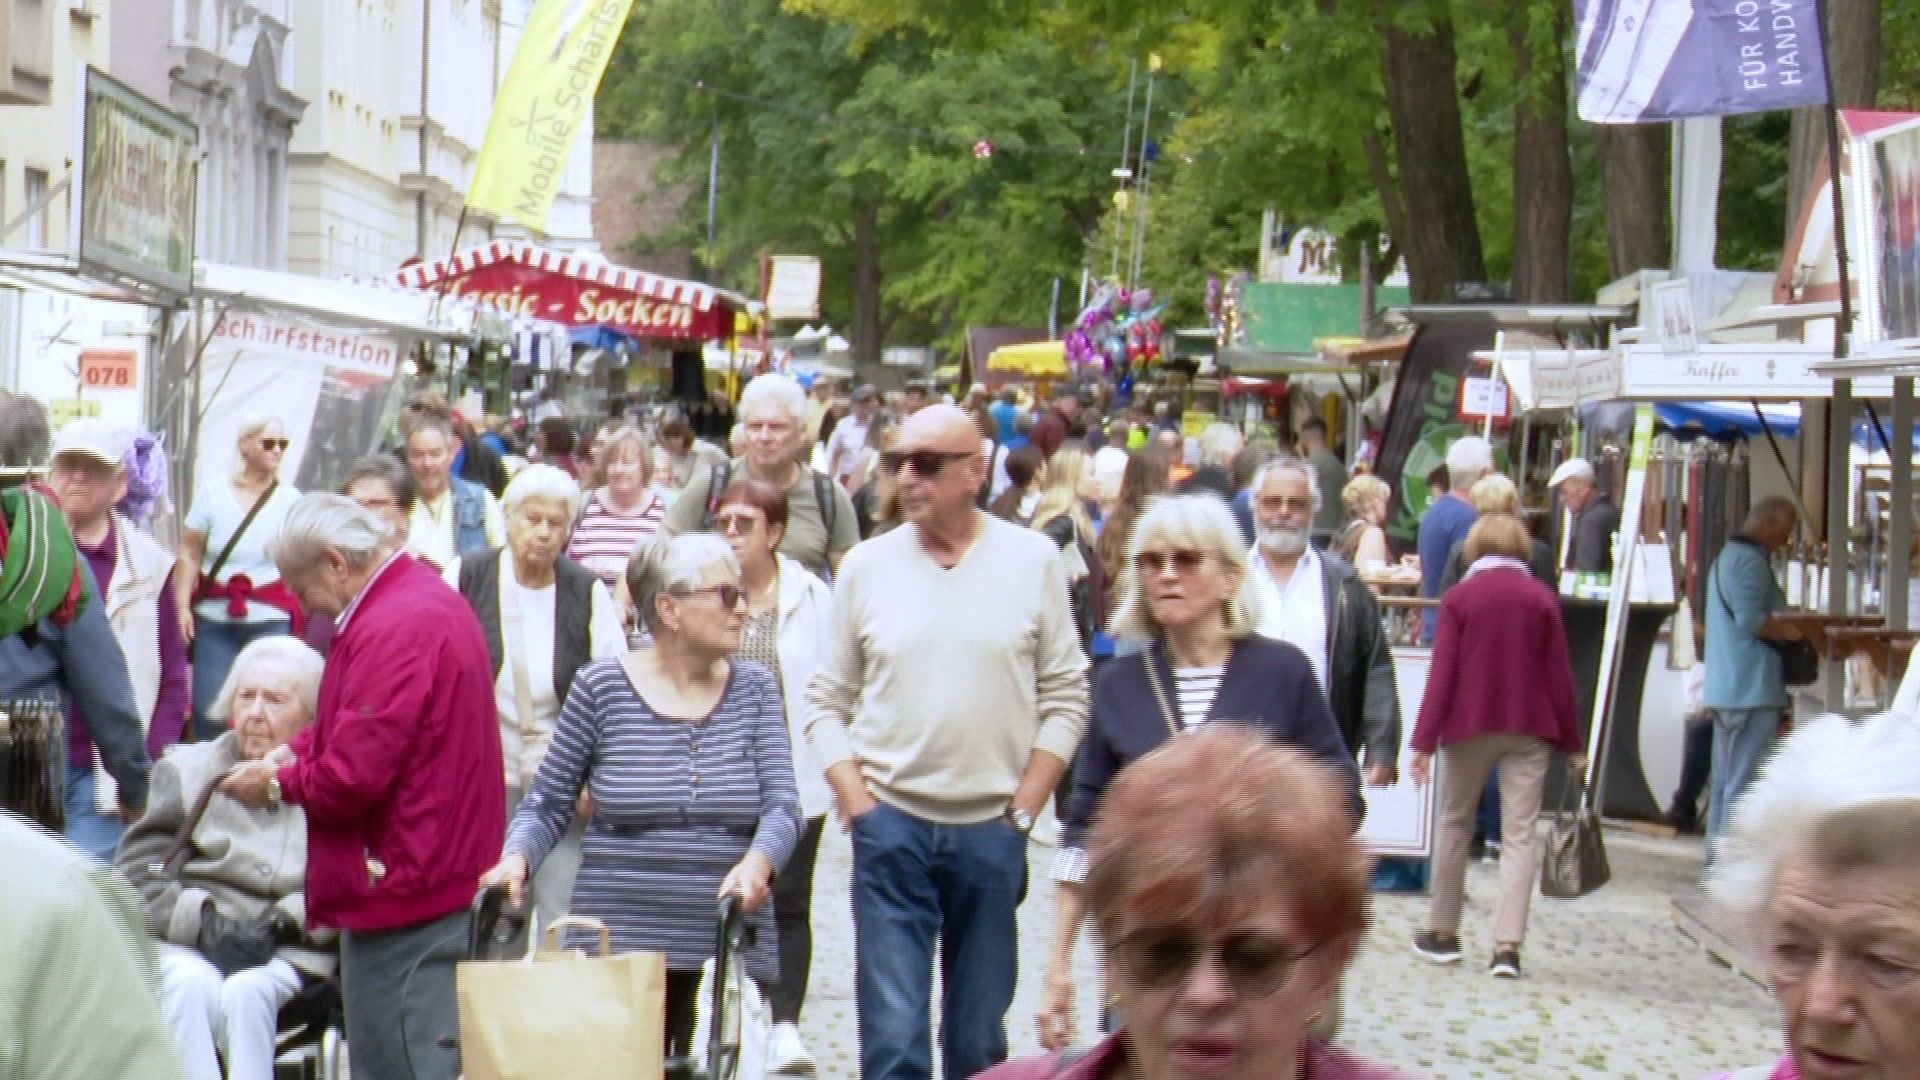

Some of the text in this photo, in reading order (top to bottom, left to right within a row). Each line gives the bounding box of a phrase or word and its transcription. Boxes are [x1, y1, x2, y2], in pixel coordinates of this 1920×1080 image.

[1739, 43, 1767, 91] FÜR
[511, 119, 570, 216] Mobile
[573, 288, 693, 328] Socken
[86, 366, 129, 387] 078
